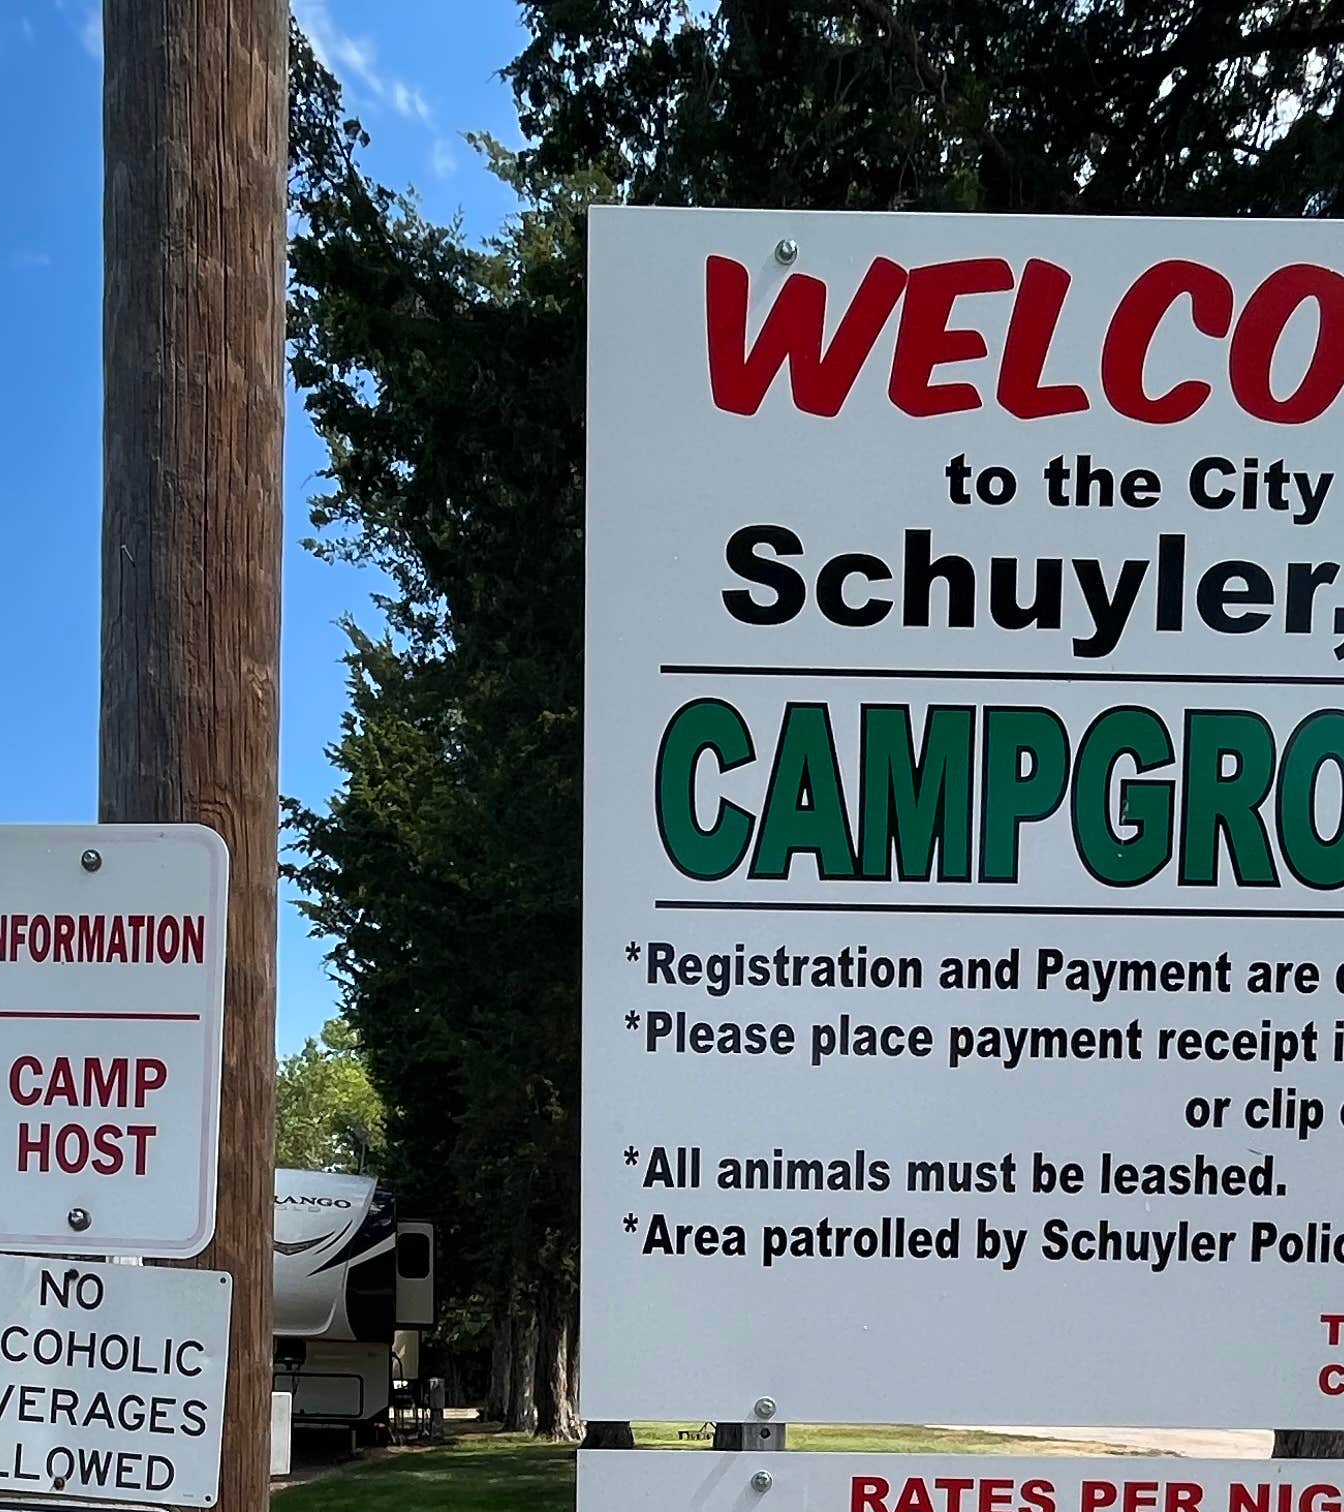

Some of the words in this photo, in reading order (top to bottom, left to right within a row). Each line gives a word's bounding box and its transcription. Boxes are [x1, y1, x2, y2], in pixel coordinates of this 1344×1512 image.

[946, 454, 1016, 505] to
[1044, 455, 1161, 508] the
[1190, 457, 1334, 525] City
[940, 949, 1019, 989] and
[1038, 949, 1231, 1002] Payment
[1248, 962, 1319, 993] are
[812, 1015, 932, 1066] place
[950, 1019, 1142, 1069] payment
[1159, 1020, 1317, 1072] receipt
[10, 1056, 166, 1107] CAMP
[1186, 1098, 1231, 1128] or
[1245, 1088, 1323, 1140] clip
[18, 1123, 156, 1175] HOST
[718, 1149, 890, 1191] animals
[908, 1153, 1016, 1192] must
[1033, 1152, 1084, 1193] be
[1101, 1153, 1286, 1196] leashed.
[763, 1217, 959, 1266] patrolled
[977, 1219, 1027, 1270] by
[1042, 1219, 1236, 1272] Schuyler
[40, 1269, 103, 1310] NO
